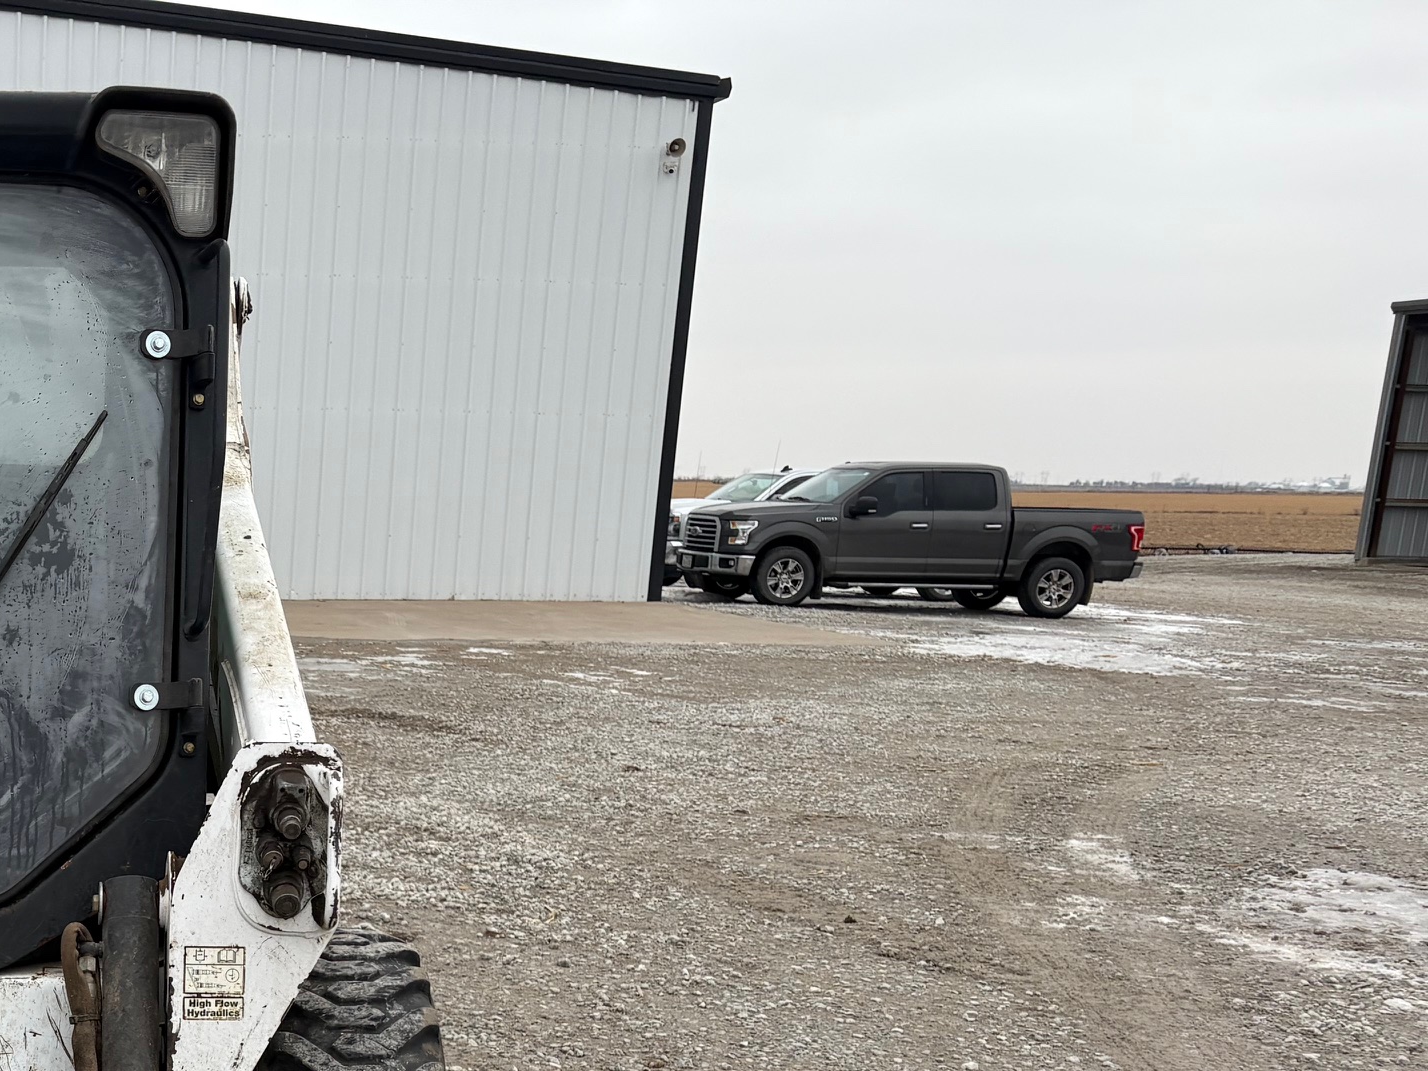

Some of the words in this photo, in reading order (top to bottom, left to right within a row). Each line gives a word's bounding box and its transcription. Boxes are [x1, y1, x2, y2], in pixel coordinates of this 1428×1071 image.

[189, 999, 211, 1008] High
[215, 999, 238, 1007] Flow
[187, 1009, 240, 1017] Hydraulics
